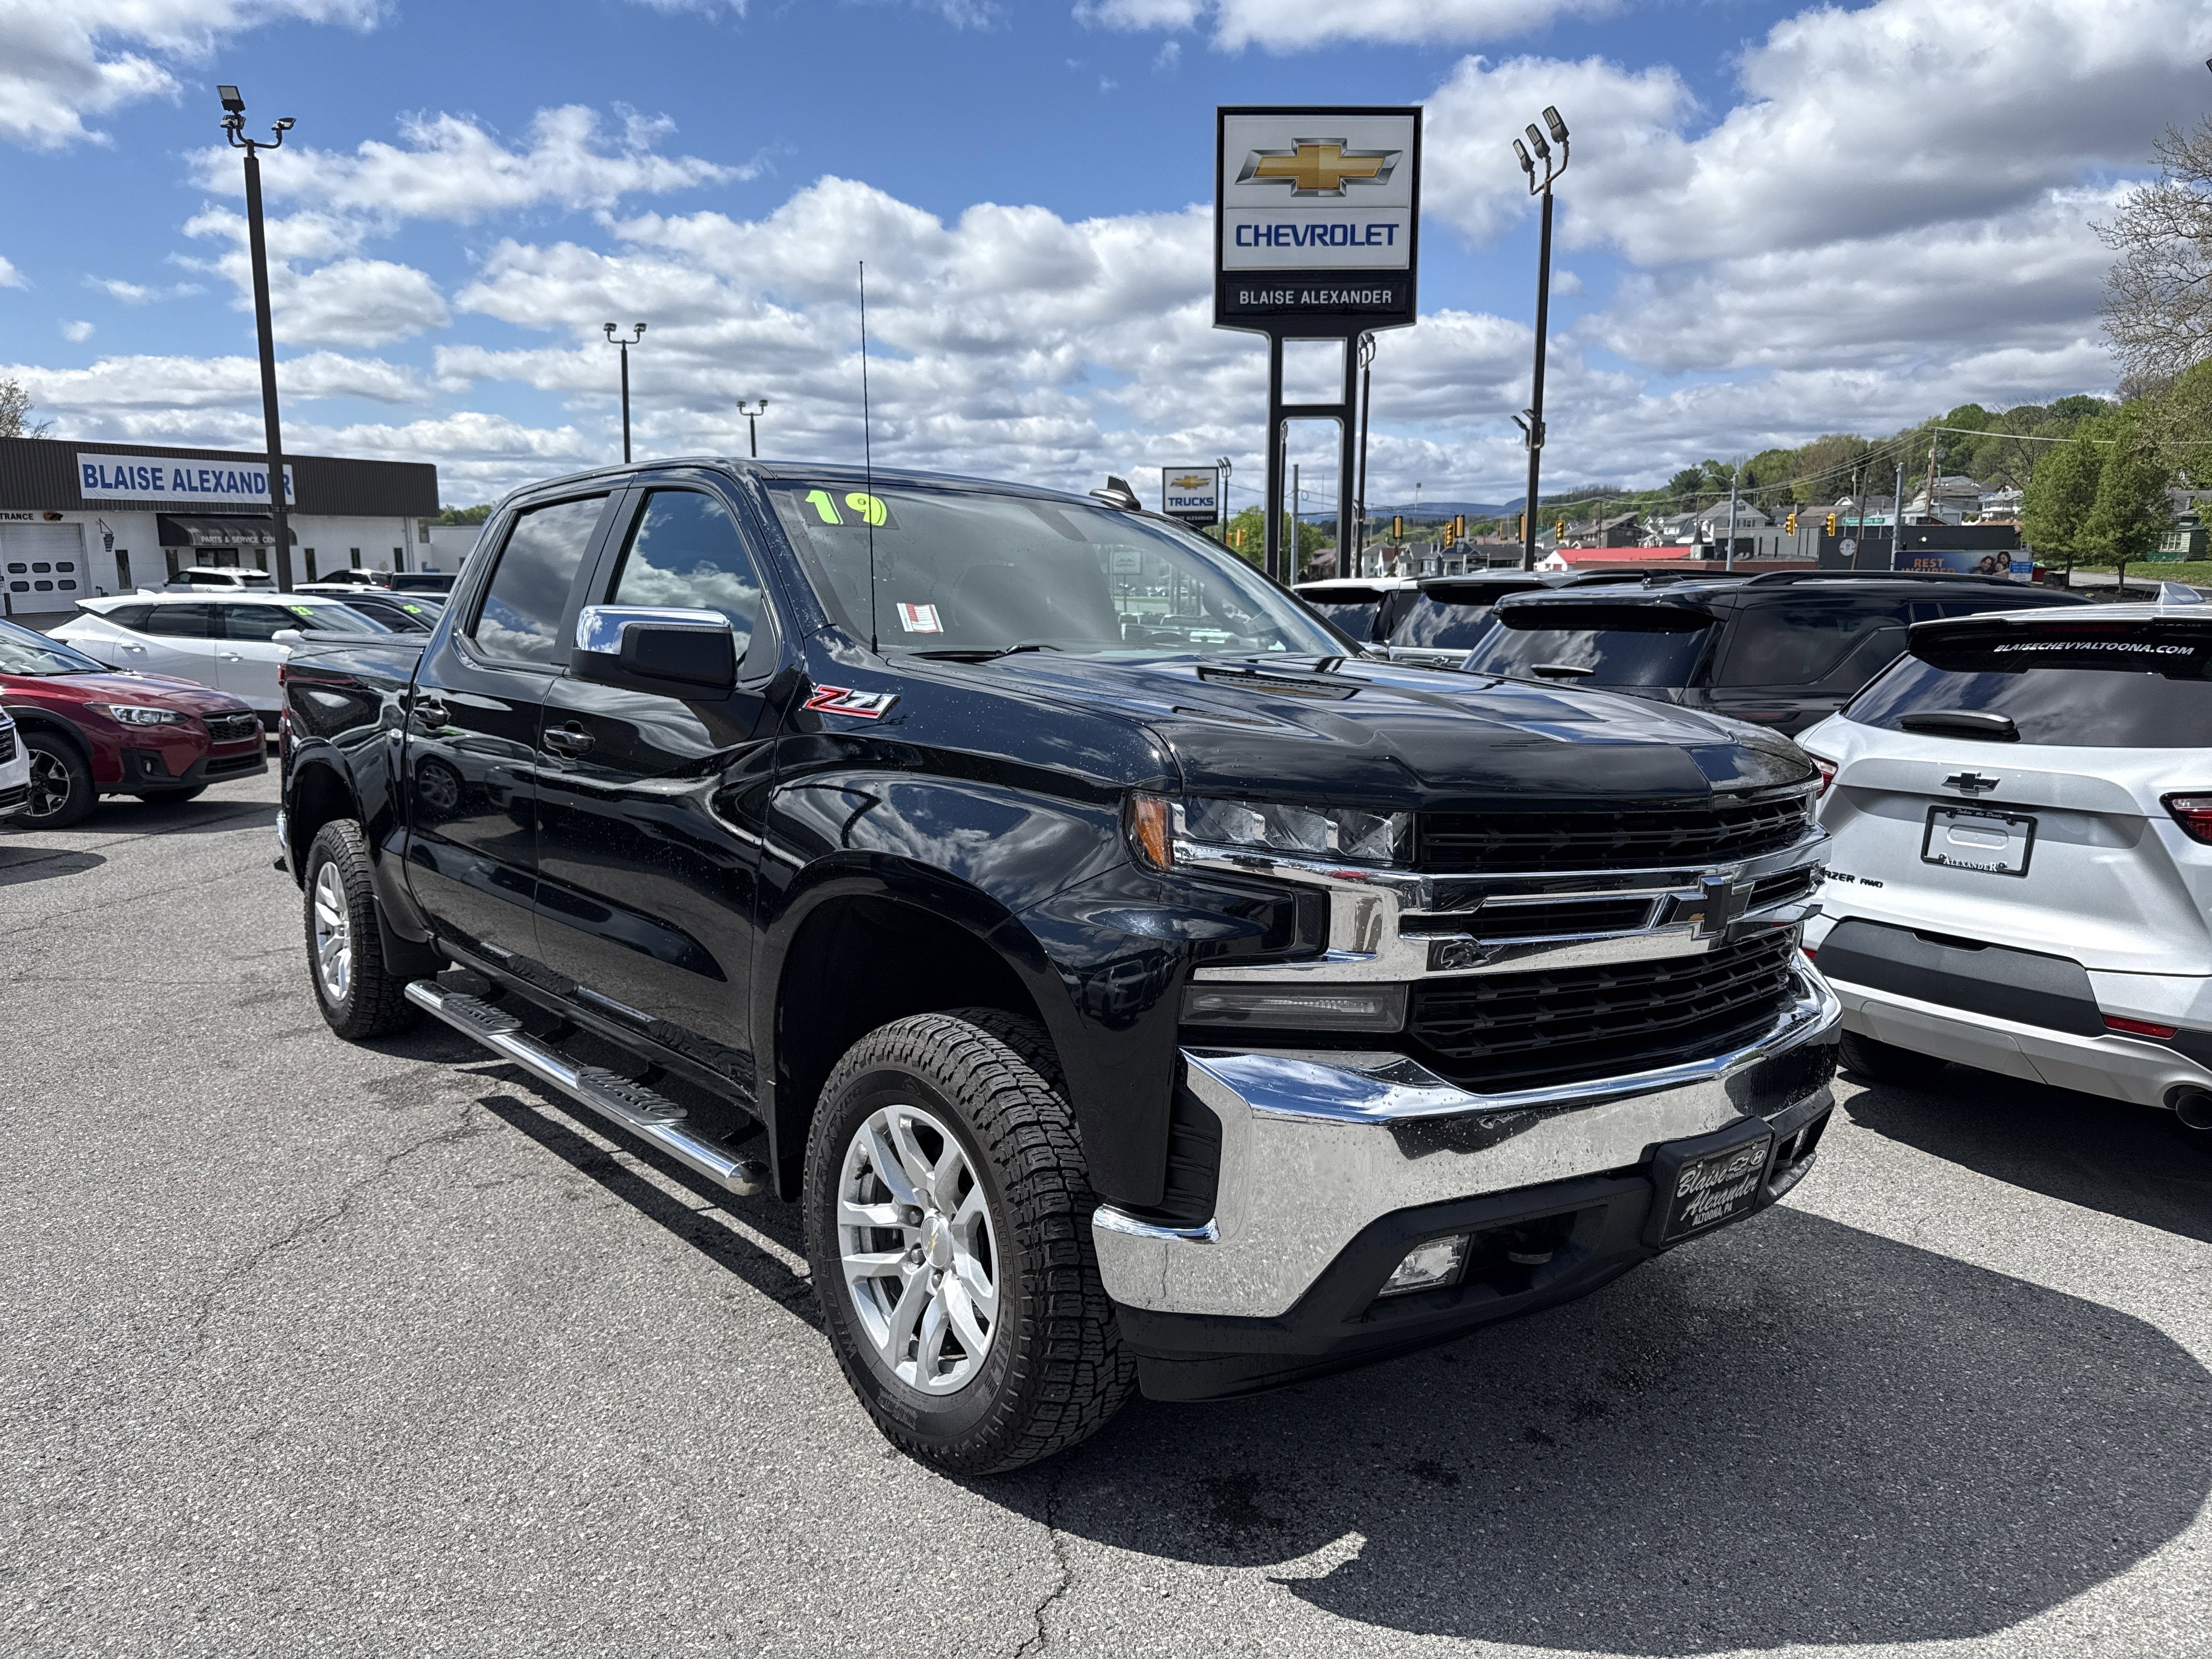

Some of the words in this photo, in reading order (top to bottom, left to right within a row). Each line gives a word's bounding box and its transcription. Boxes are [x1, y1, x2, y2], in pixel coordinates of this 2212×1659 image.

[1235, 224, 1399, 247] CHEVROLET
[1239, 291, 1294, 304] BLAISE
[1300, 290, 1392, 304] ALEXANDER
[82, 464, 165, 491] BLAISE
[172, 468, 292, 495] ALEXANDR
[805, 490, 888, 526] 19
[1168, 497, 1214, 506] TRUCKS
[1914, 558, 1945, 568] REST
[1994, 642, 2195, 656] BLAISECHEVYALTOONA.COM
[802, 684, 900, 719] Z71
[1825, 870, 1855, 884] AZER
[1860, 878, 1883, 888] AWD
[1677, 1169, 1727, 1198] Blaise
[1680, 1173, 1759, 1221] Alexander
[1724, 1201, 1733, 1214] PA
